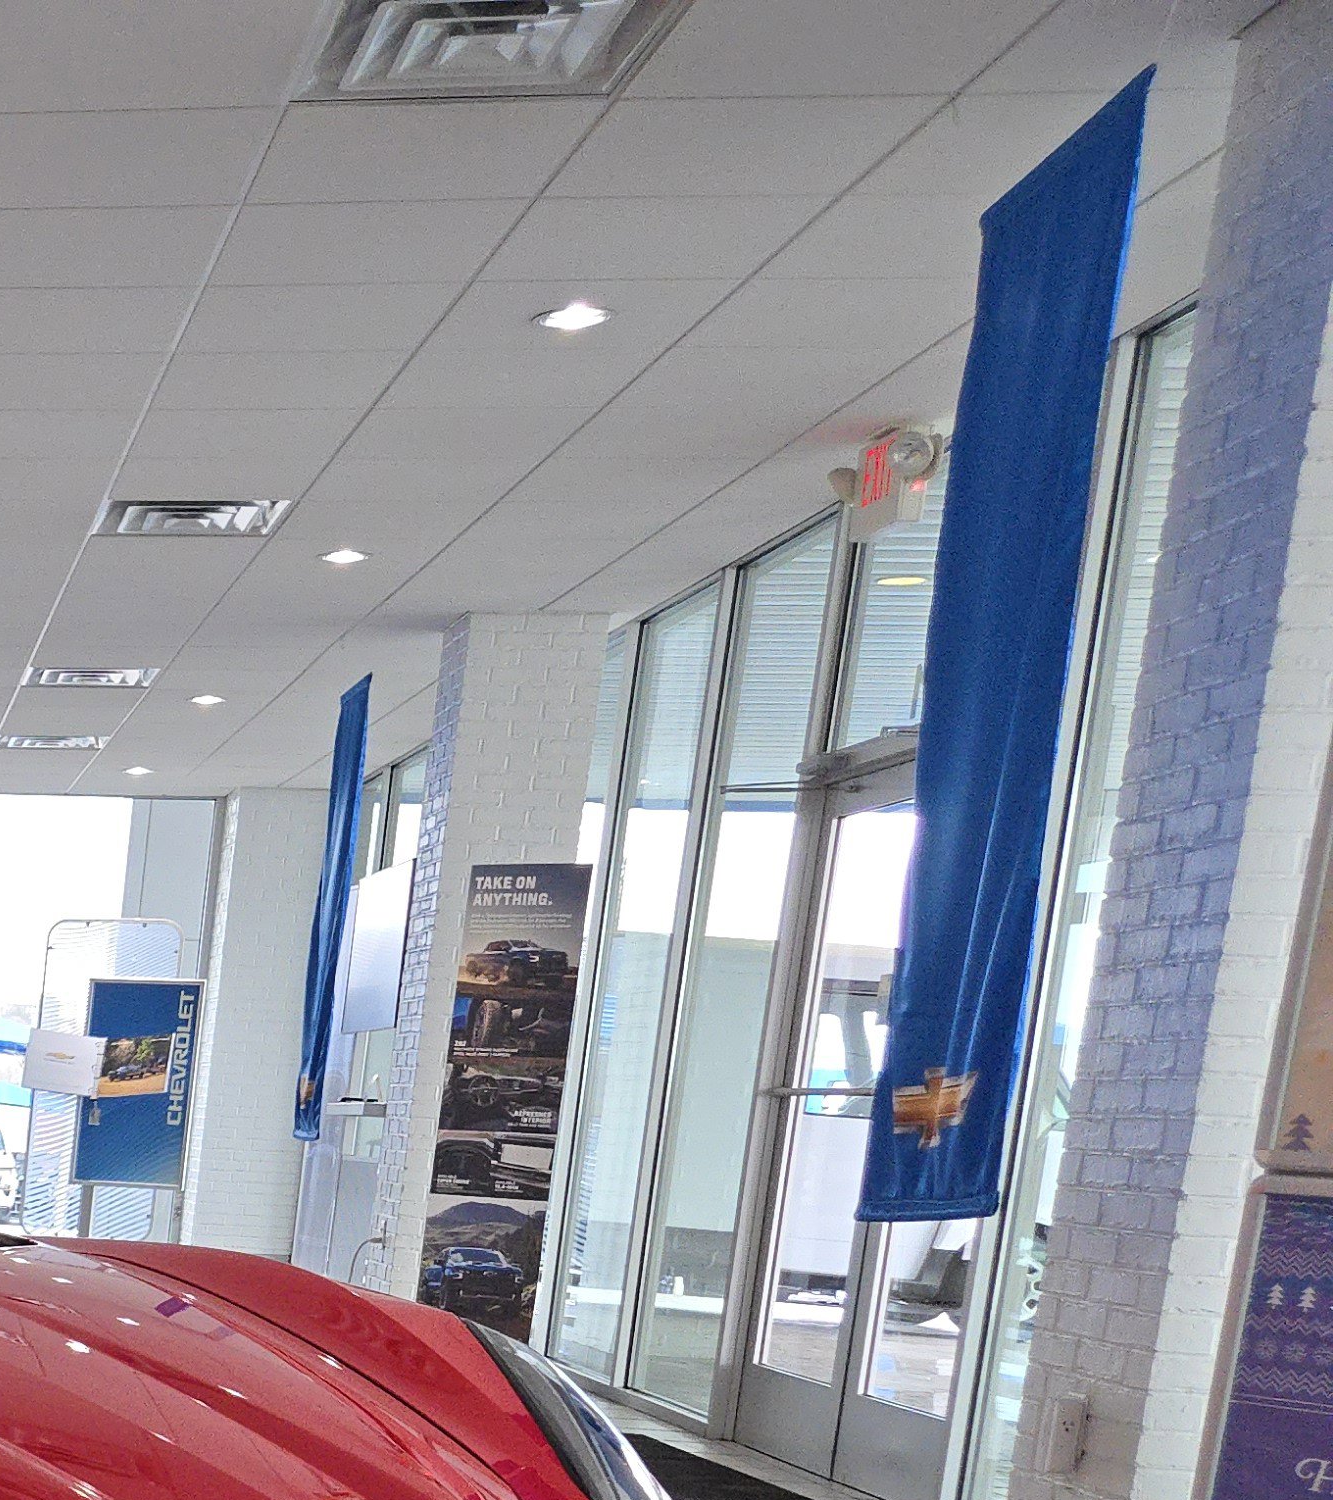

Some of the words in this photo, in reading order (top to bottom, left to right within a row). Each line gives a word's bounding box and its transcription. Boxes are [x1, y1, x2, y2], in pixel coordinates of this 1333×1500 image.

[475, 876, 513, 890] TAKE
[515, 876, 537, 889] ON
[472, 892, 554, 906] ANYTHING.
[166, 989, 196, 1126] CHEVROLET
